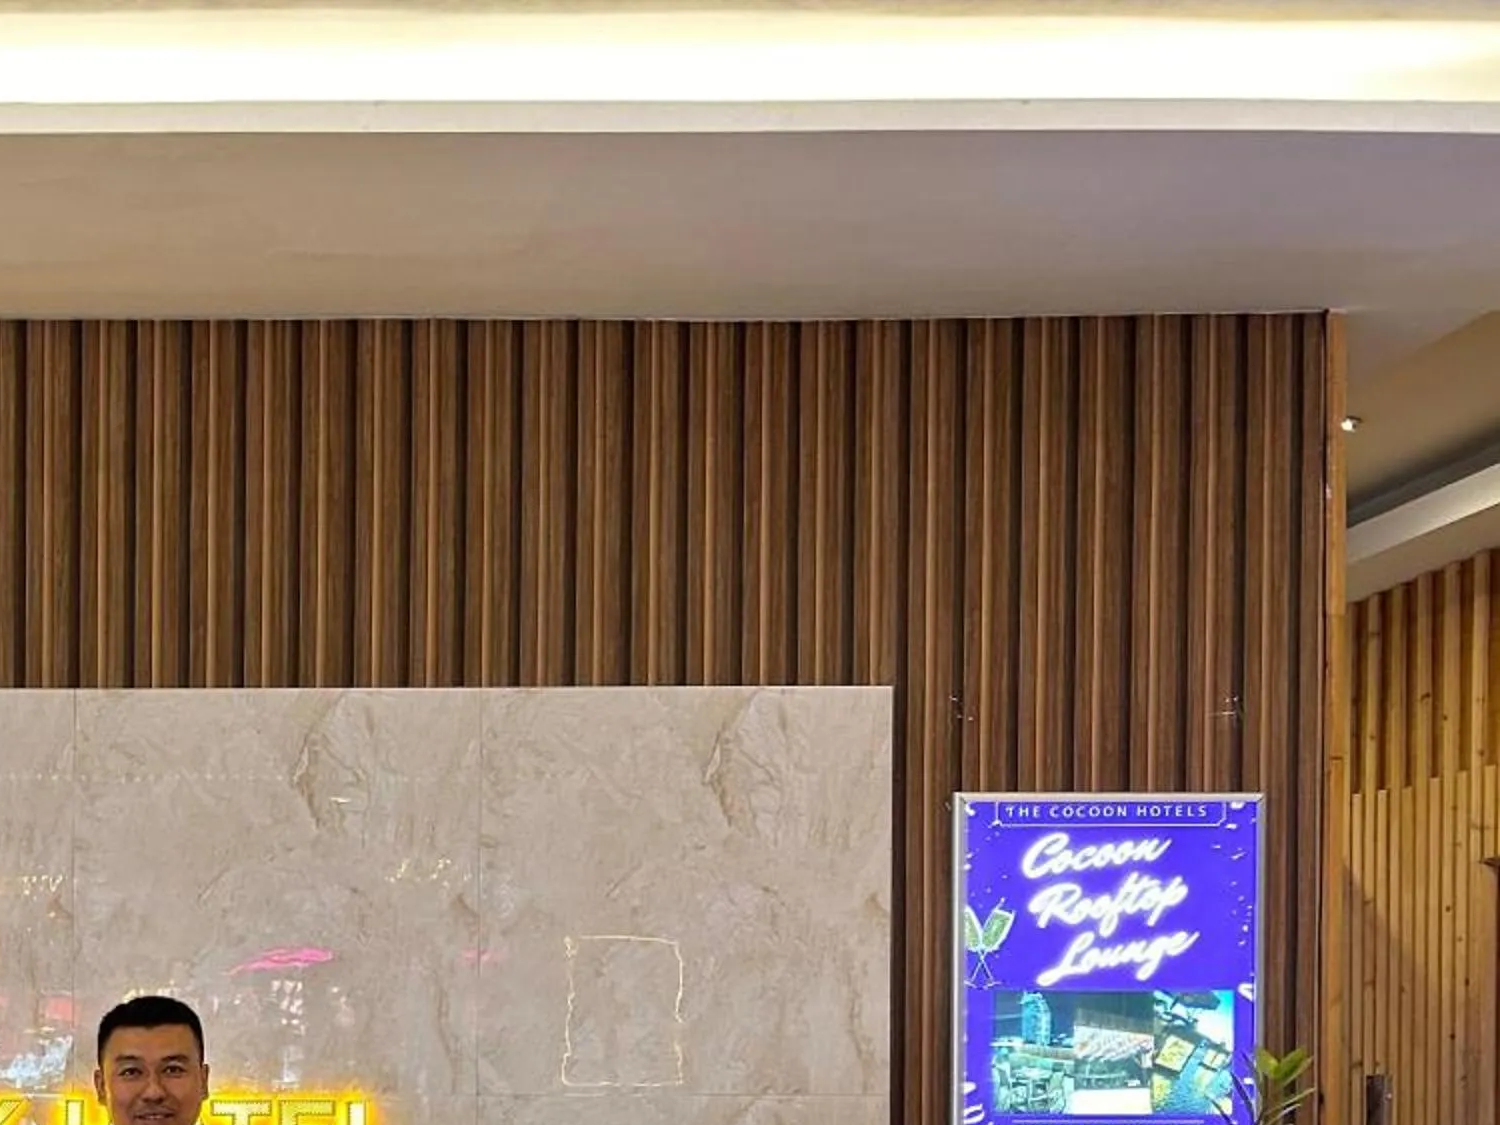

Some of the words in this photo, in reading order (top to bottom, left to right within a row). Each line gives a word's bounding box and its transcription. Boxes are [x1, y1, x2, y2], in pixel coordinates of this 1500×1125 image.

[1005, 805, 1041, 818] THE
[1050, 805, 1128, 818] COCOON
[1136, 805, 1208, 817] HOTELS
[1020, 831, 1173, 879] Cocoon
[1027, 871, 1190, 938] Rooftop
[1035, 931, 1201, 987] Lounge
